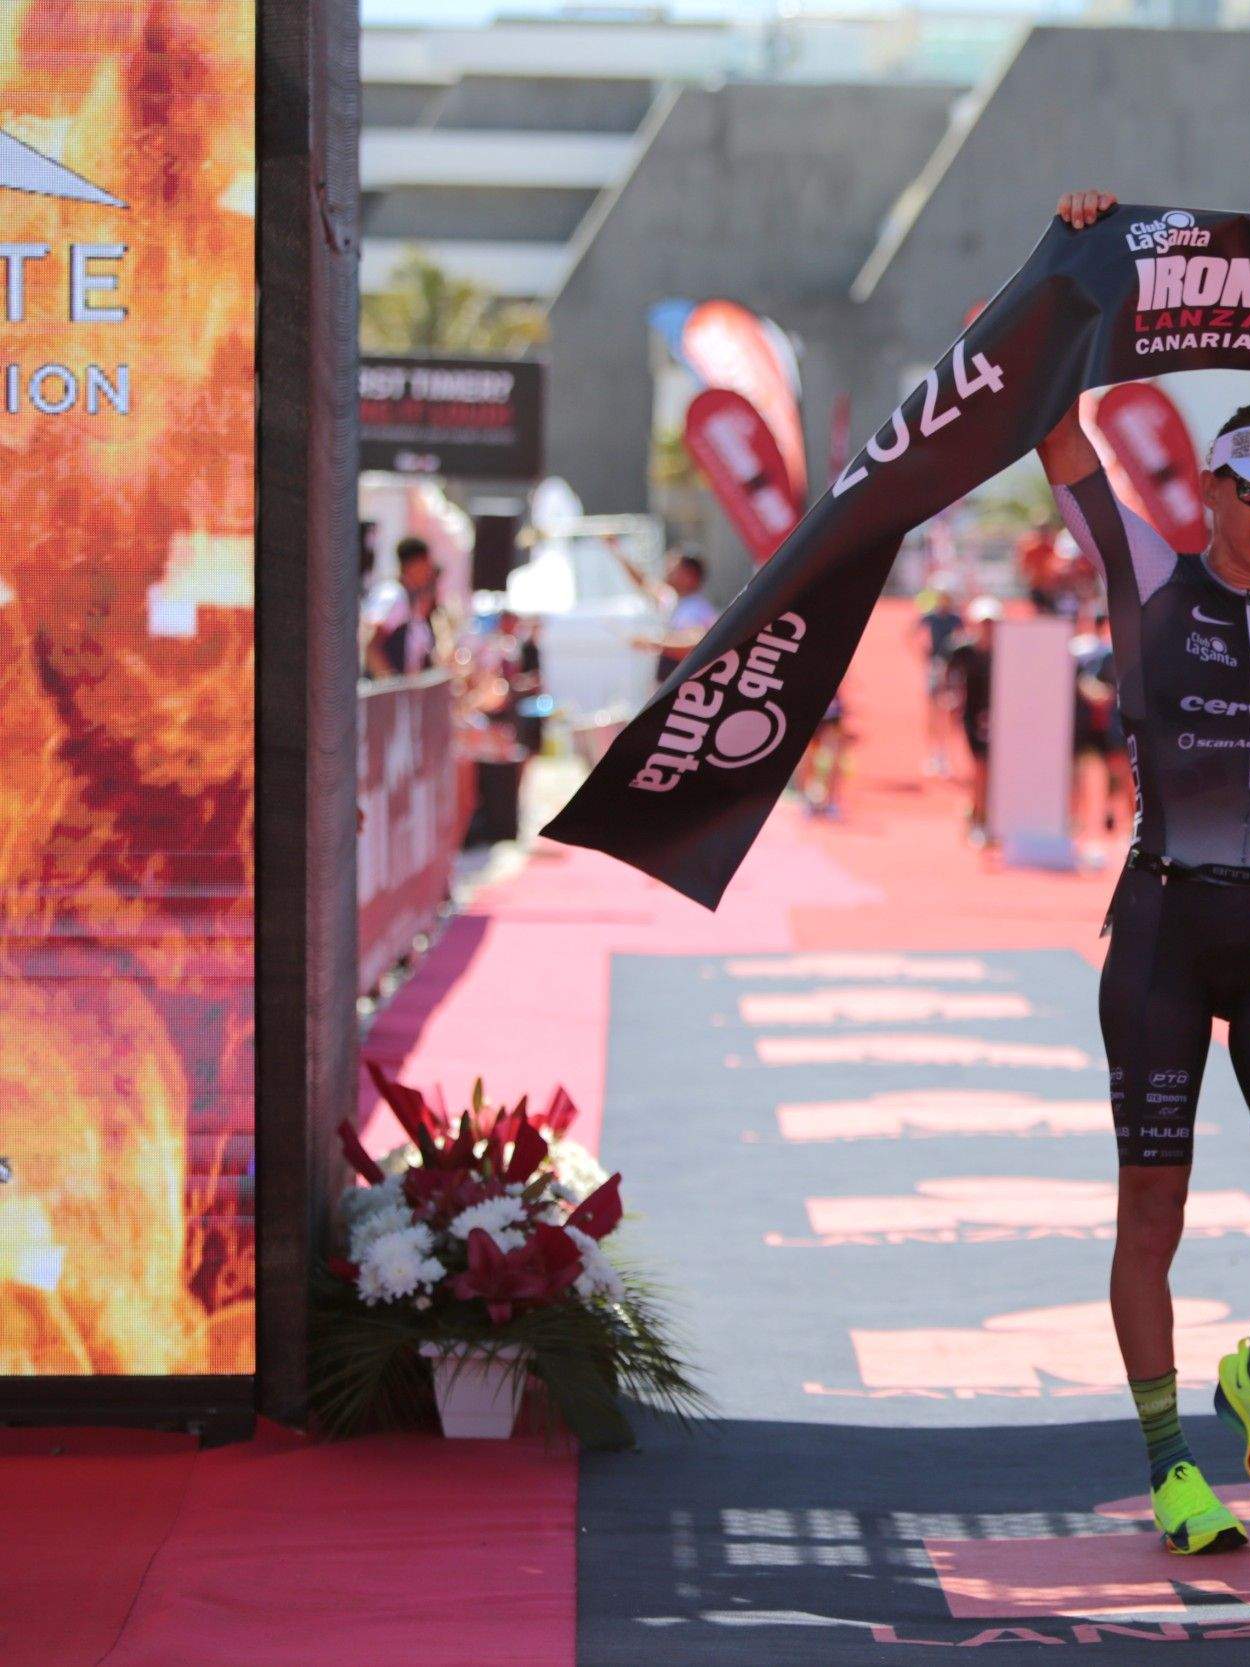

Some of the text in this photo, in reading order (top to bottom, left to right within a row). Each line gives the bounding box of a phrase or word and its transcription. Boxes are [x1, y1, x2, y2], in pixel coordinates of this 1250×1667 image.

[1130, 220, 1166, 235] Club
[738, 611, 807, 699] Club
[1140, 1127, 1190, 1138] HUUB
